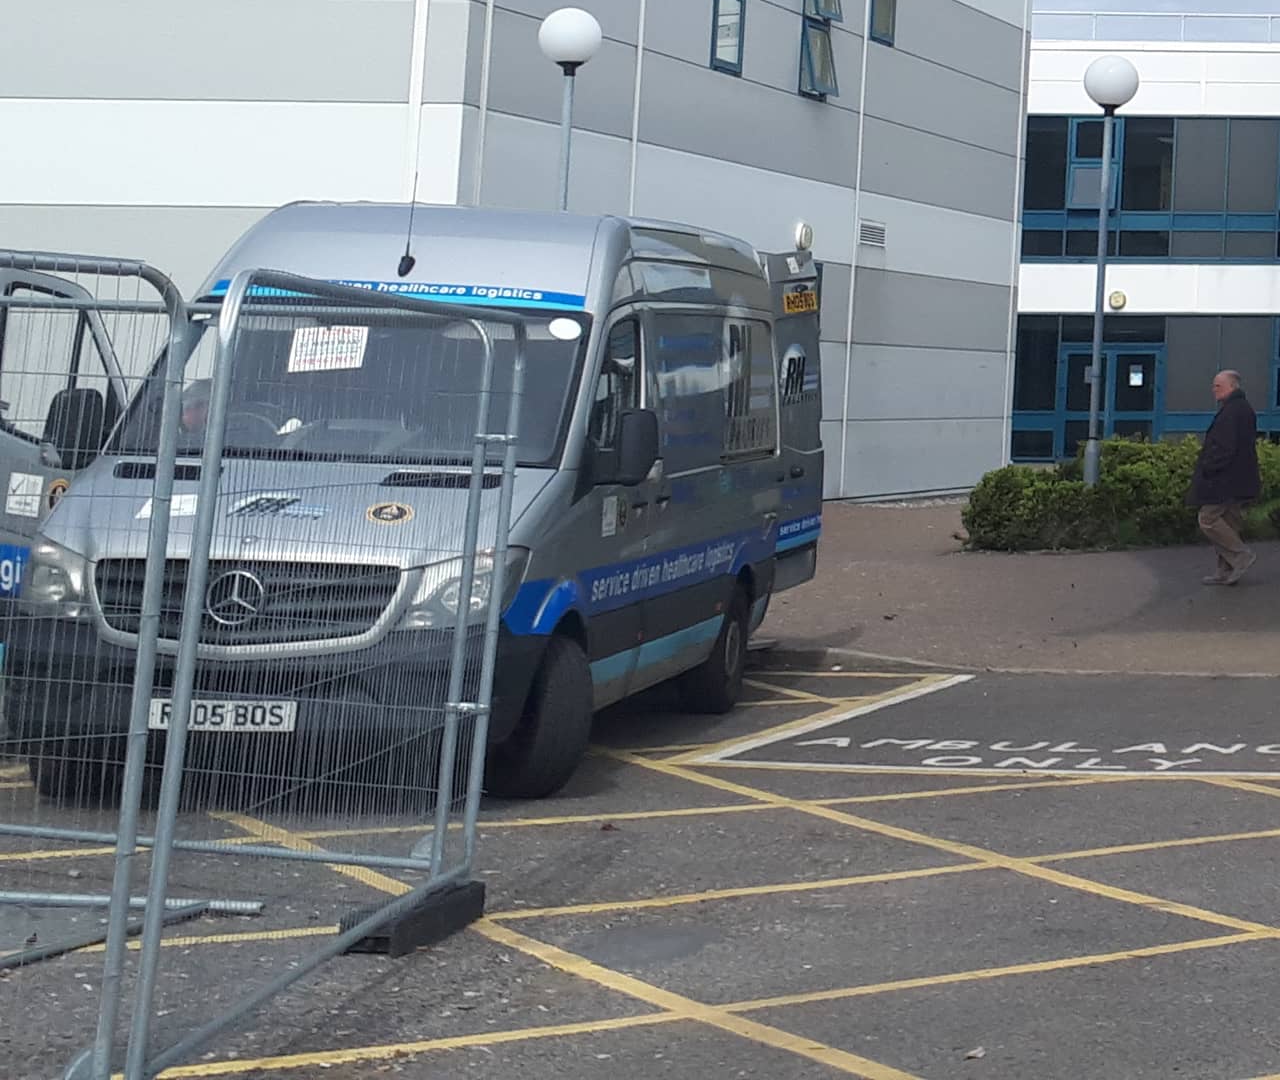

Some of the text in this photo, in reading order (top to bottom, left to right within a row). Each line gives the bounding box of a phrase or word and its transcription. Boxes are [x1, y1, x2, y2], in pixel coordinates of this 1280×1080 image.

[377, 283, 466, 295] healthcare
[471, 286, 543, 300] logistics
[591, 543, 736, 602] service driven healthcare logistics
[160, 702, 284, 727] R05 BOS
[921, 756, 1202, 770] ONLY
